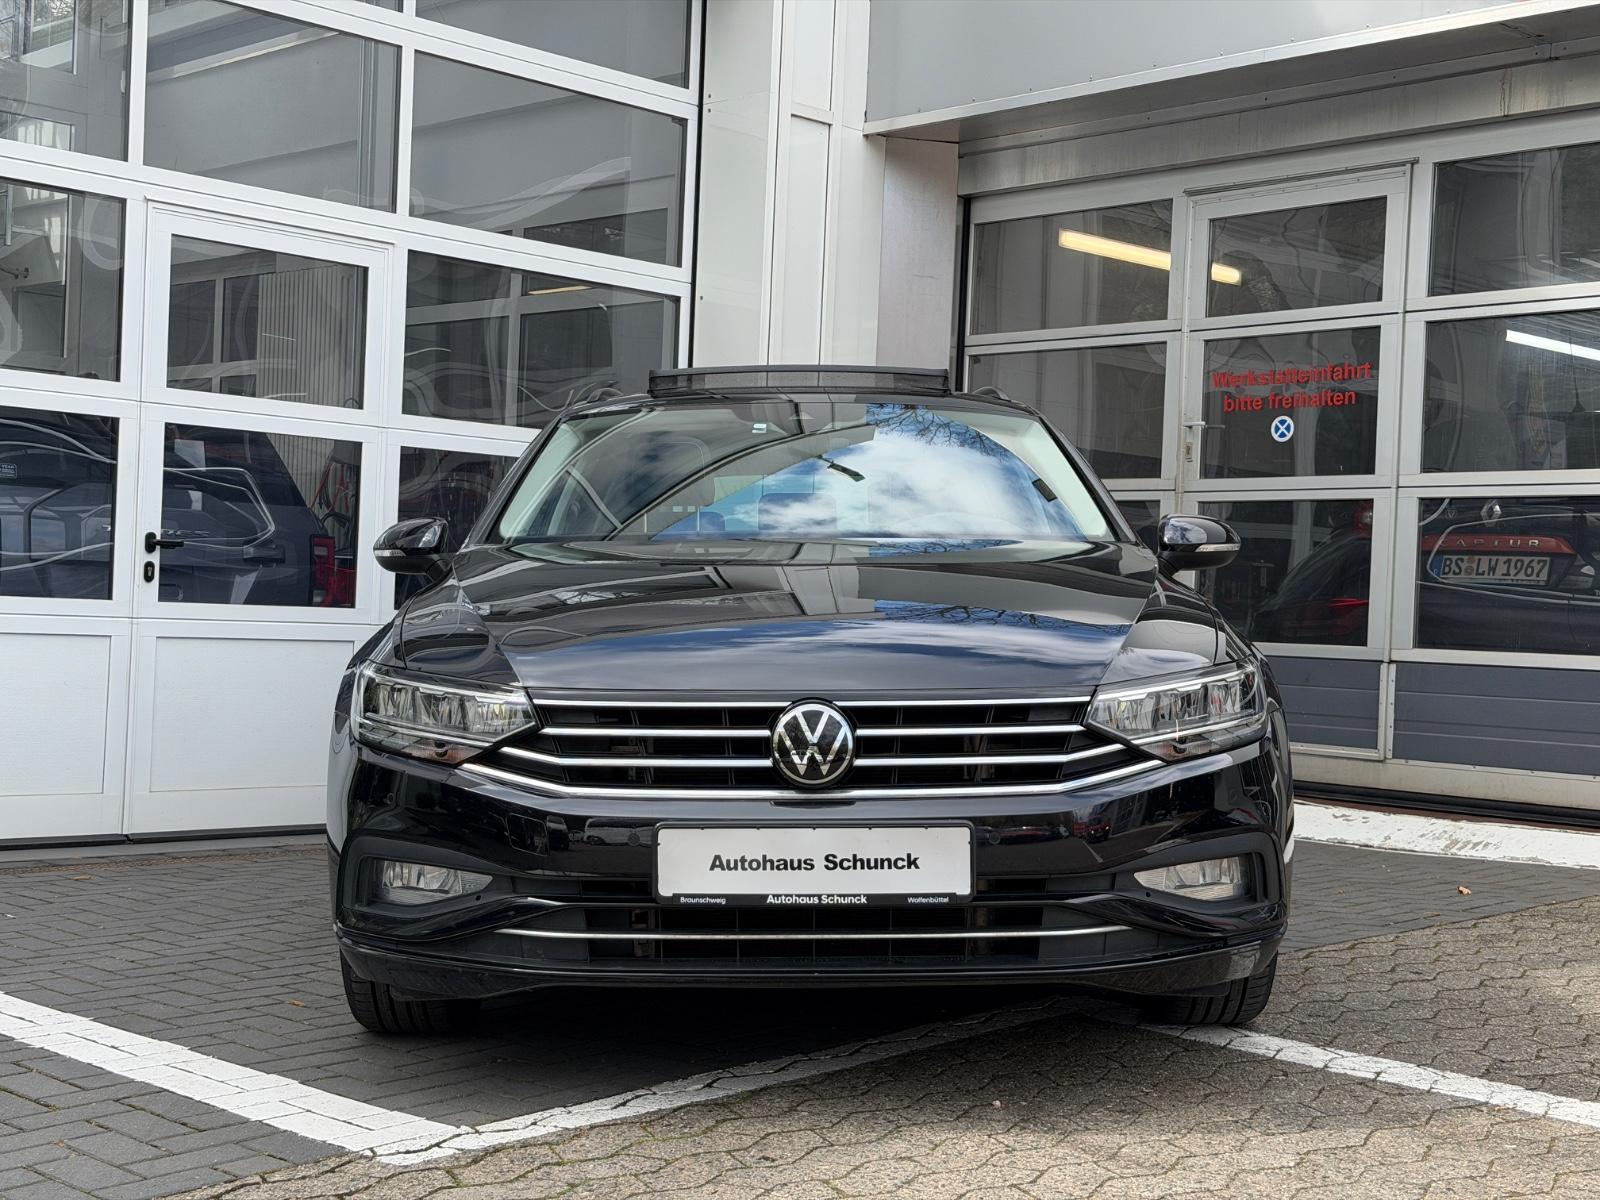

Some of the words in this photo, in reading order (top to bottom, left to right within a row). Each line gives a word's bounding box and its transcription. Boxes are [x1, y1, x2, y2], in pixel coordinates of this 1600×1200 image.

[1212, 362, 1372, 388] Werkstatteinfahrt
[1223, 395, 1263, 412] bitte
[1269, 390, 1356, 409] freihalten
[1442, 557, 1464, 576] BS
[1501, 558, 1548, 578] 1967
[709, 854, 815, 871] Autohaus
[823, 853, 920, 870] Schunck
[680, 896, 726, 904] Braunschweig
[766, 894, 819, 904] Autohaus
[821, 894, 868, 904] Schunck
